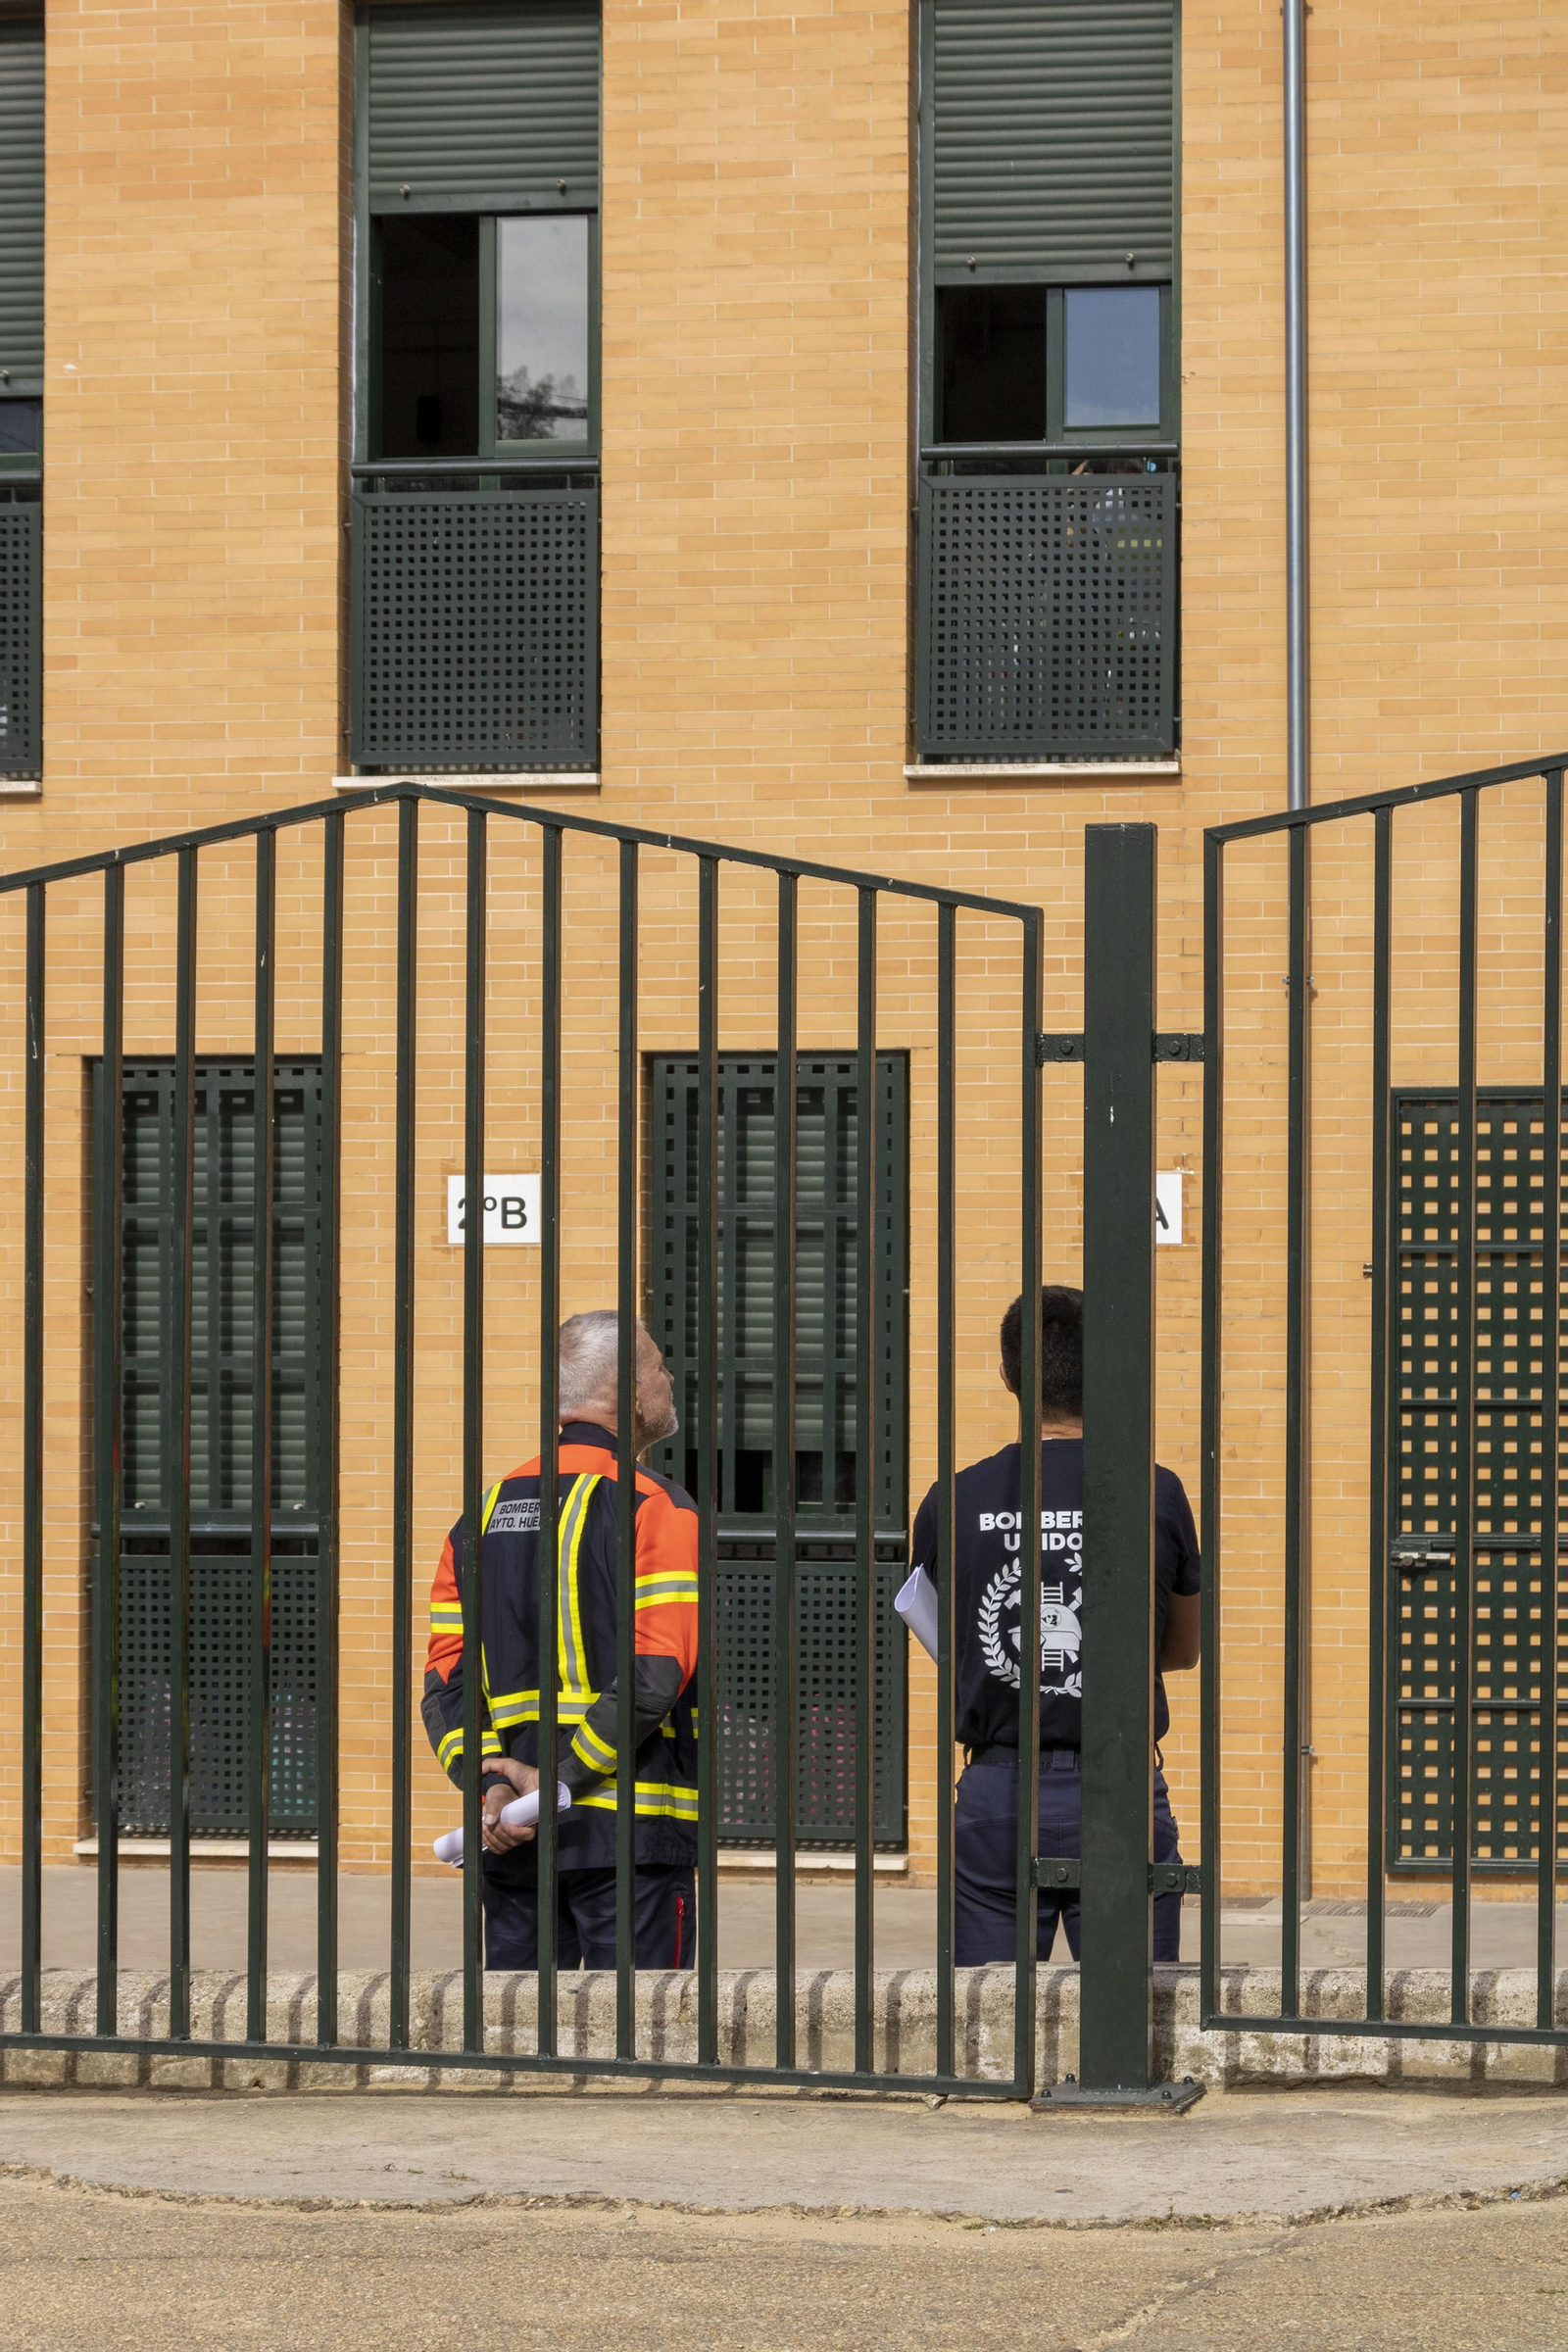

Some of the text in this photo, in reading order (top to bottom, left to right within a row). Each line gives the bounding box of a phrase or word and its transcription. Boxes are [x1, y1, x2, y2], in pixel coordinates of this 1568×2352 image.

[499, 1502, 540, 1514] BOMBER
[490, 1516, 540, 1530] AYTO. HUE
[980, 1511, 1083, 1531] BOBER
[1004, 1533, 1083, 1551] UIDO
